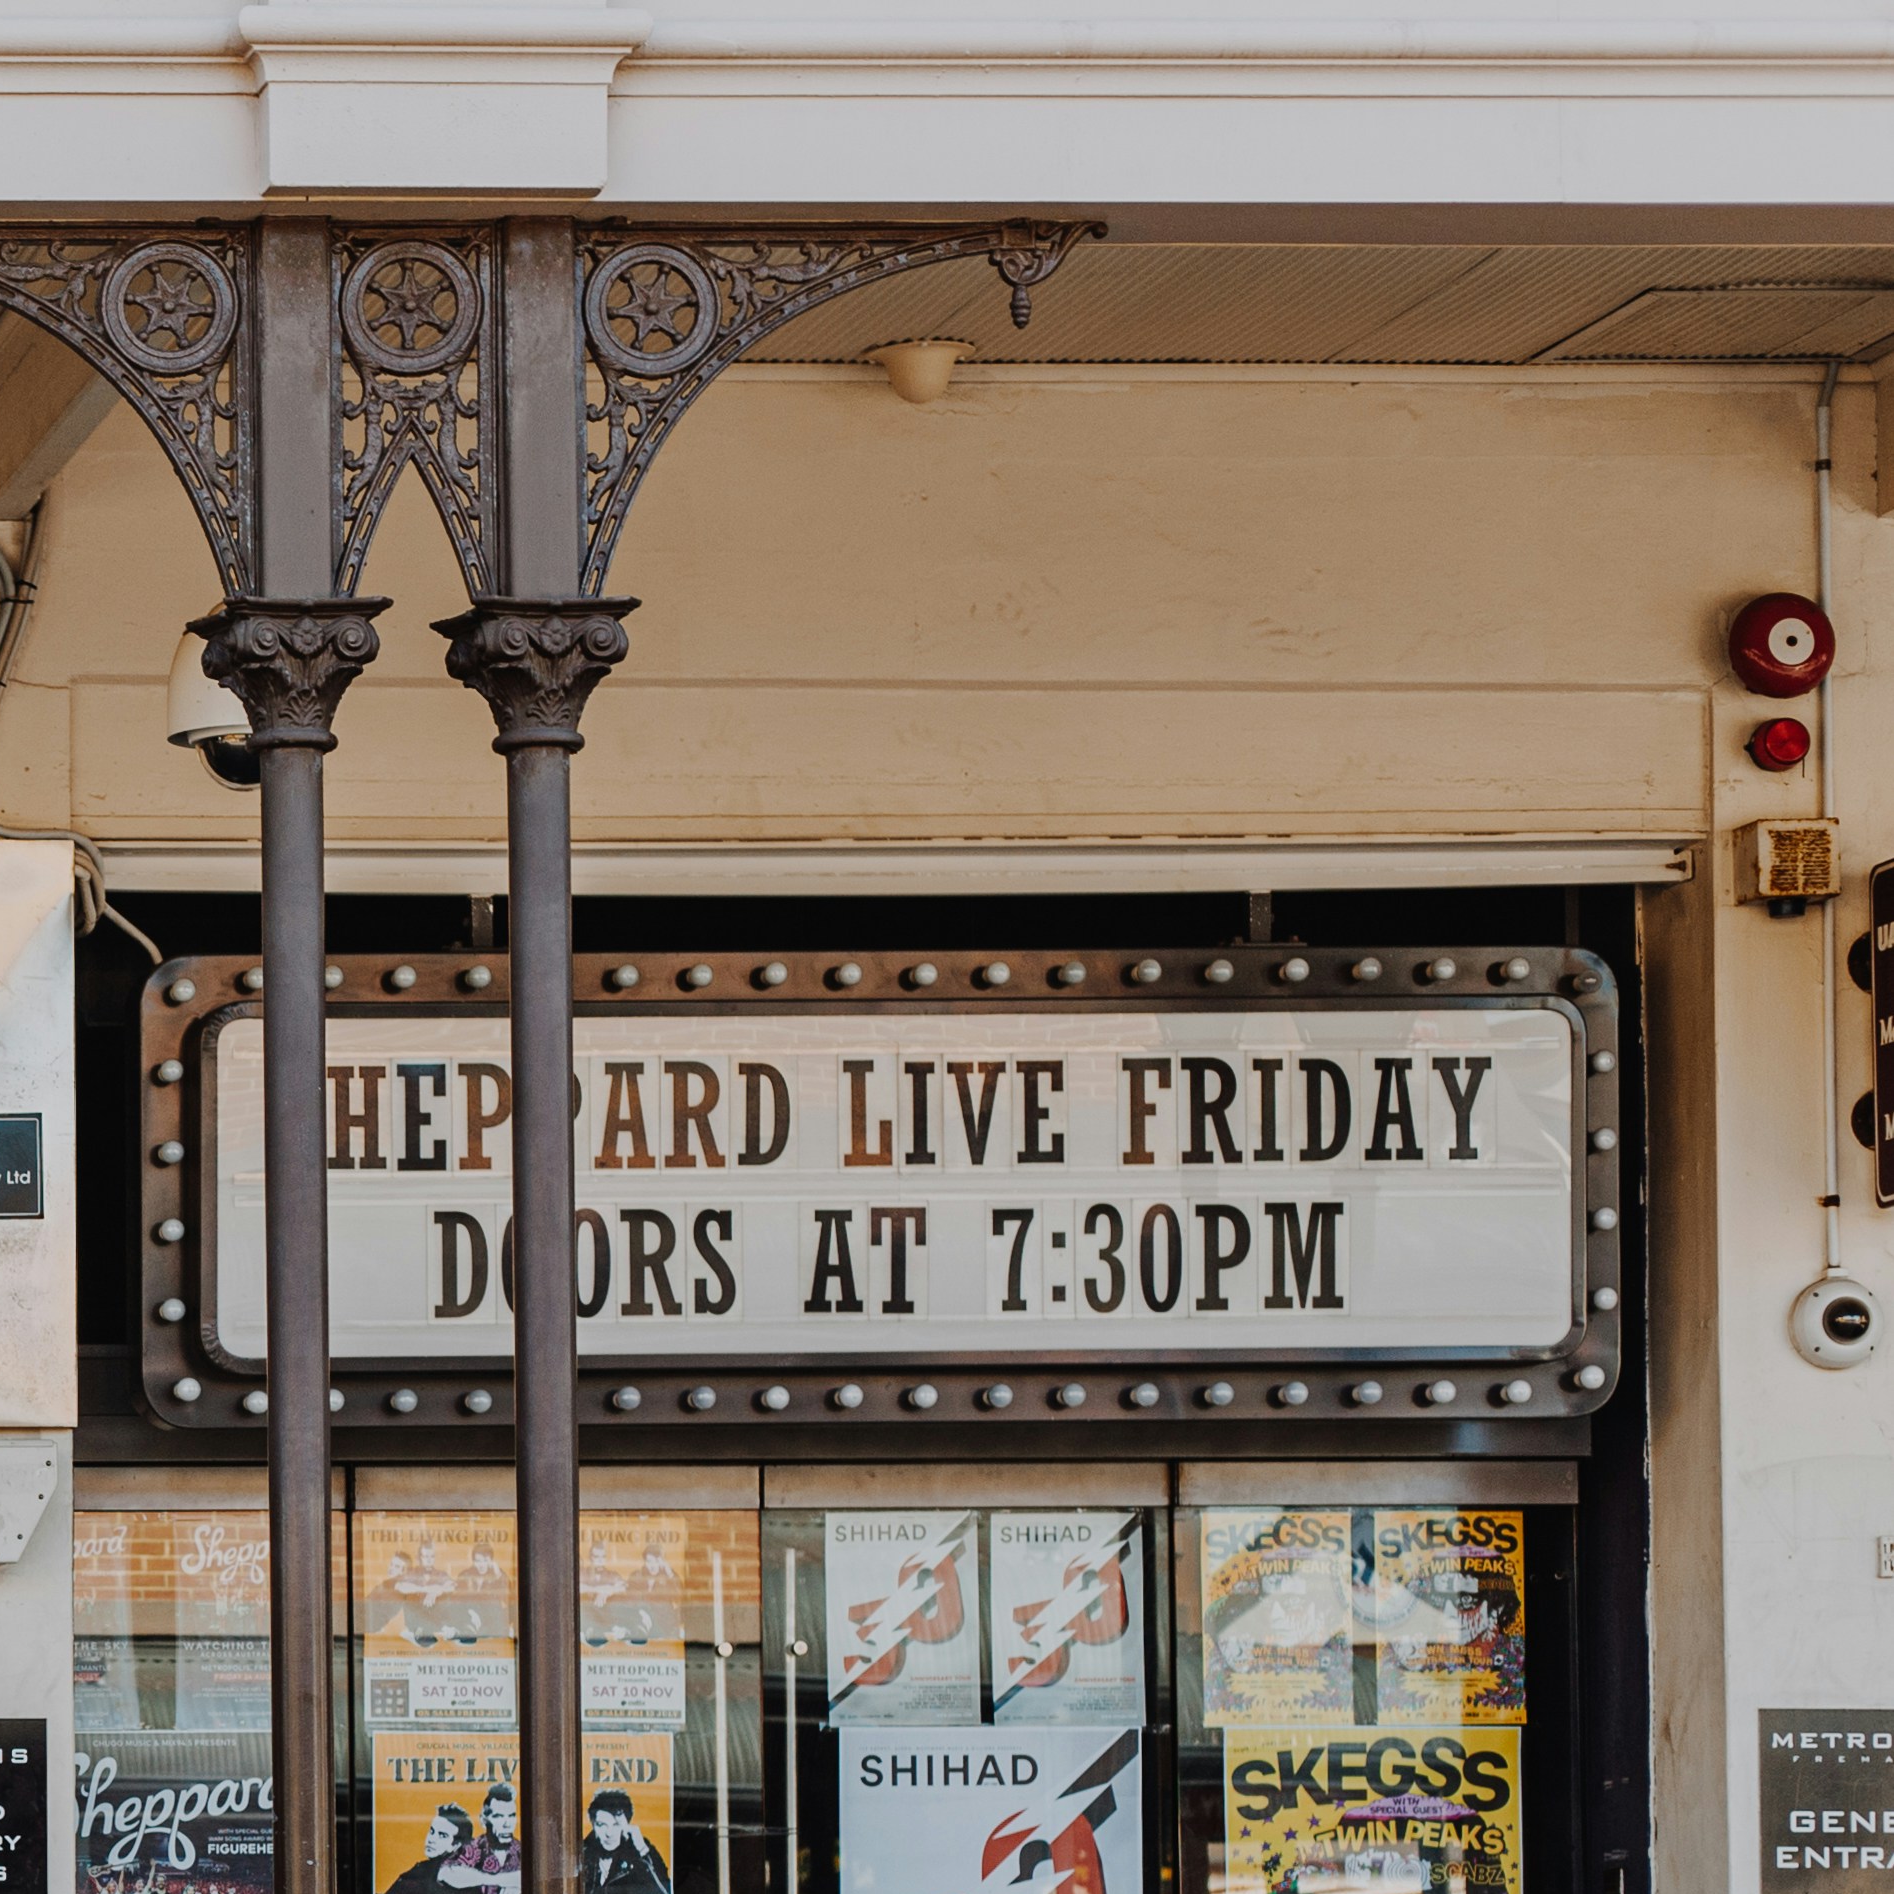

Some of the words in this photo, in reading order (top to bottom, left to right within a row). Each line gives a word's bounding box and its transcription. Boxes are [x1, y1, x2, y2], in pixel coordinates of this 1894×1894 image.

[327, 1053, 792, 1173] HEPARD
[841, 1058, 1066, 1168] LIVE
[1121, 1056, 1493, 1167] FRIDAY
[7, 1170, 30, 1184] Ltd
[433, 1208, 737, 1320] DORS
[804, 1206, 927, 1316] AT
[991, 1200, 1347, 1314] 7:30PM
[835, 1524, 927, 1543] SHIHAD
[387, 1757, 455, 1783] THE
[591, 1757, 659, 1783] END
[860, 1754, 1039, 1788] SHIHAD
[1231, 1737, 1511, 1821] SKEGSS
[1315, 1818, 1398, 1859] TWIN
[1404, 1820, 1505, 1855] PEAKS
[1431, 1864, 1506, 1886] SCABZ
